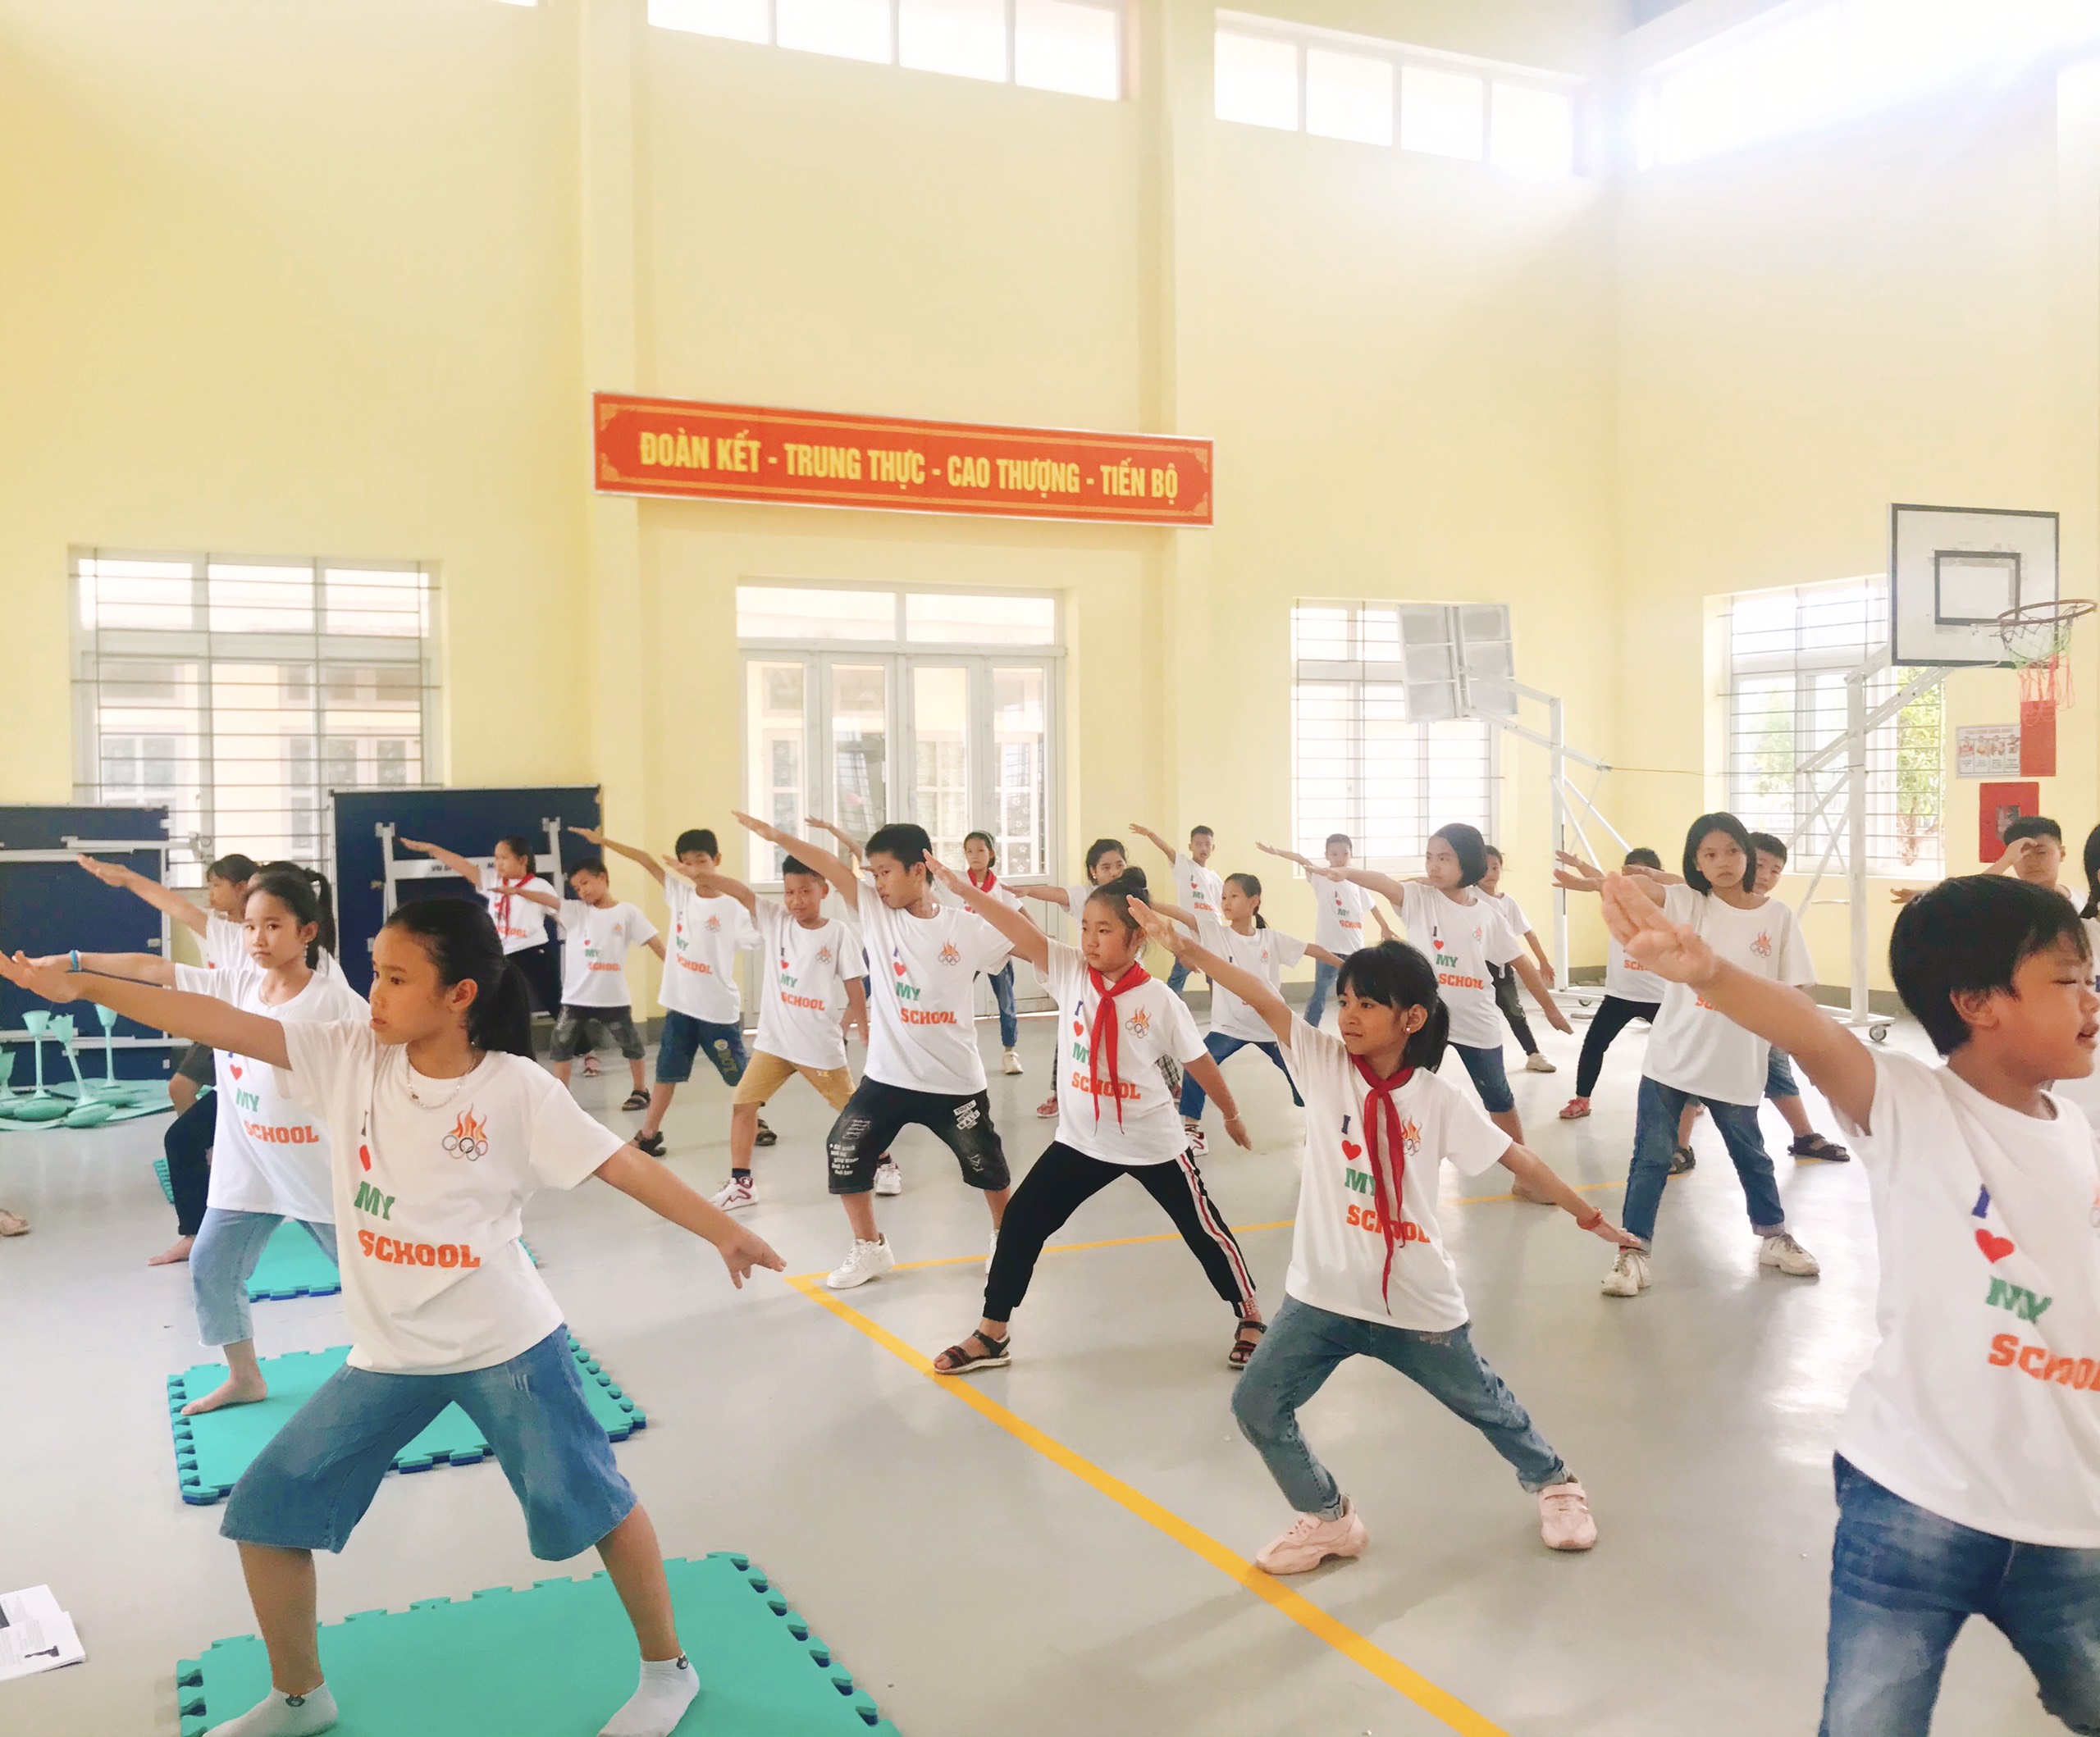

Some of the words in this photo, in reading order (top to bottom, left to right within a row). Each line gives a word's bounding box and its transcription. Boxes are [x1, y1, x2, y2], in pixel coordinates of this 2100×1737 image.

[640, 427, 710, 469] ĐOÀN
[716, 429, 762, 473] KẾT
[783, 443, 862, 481] TRUNG
[867, 449, 925, 490] THỰC
[947, 455, 991, 489] CAO
[995, 457, 1081, 499] THƯỢNG
[1099, 457, 1146, 497] TIẾN
[1151, 463, 1179, 505] BỘ
[1436, 953, 1459, 969] MY
[896, 981, 921, 1001] MY
[900, 1007, 957, 1025] SCHOOL
[235, 1087, 260, 1113] MY
[244, 1119, 320, 1145] SCHOOL
[1341, 1114, 1351, 1135] I
[354, 1180, 395, 1221] MY
[358, 1229, 481, 1269] SCHOOL
[1985, 1274, 2052, 1324] MY
